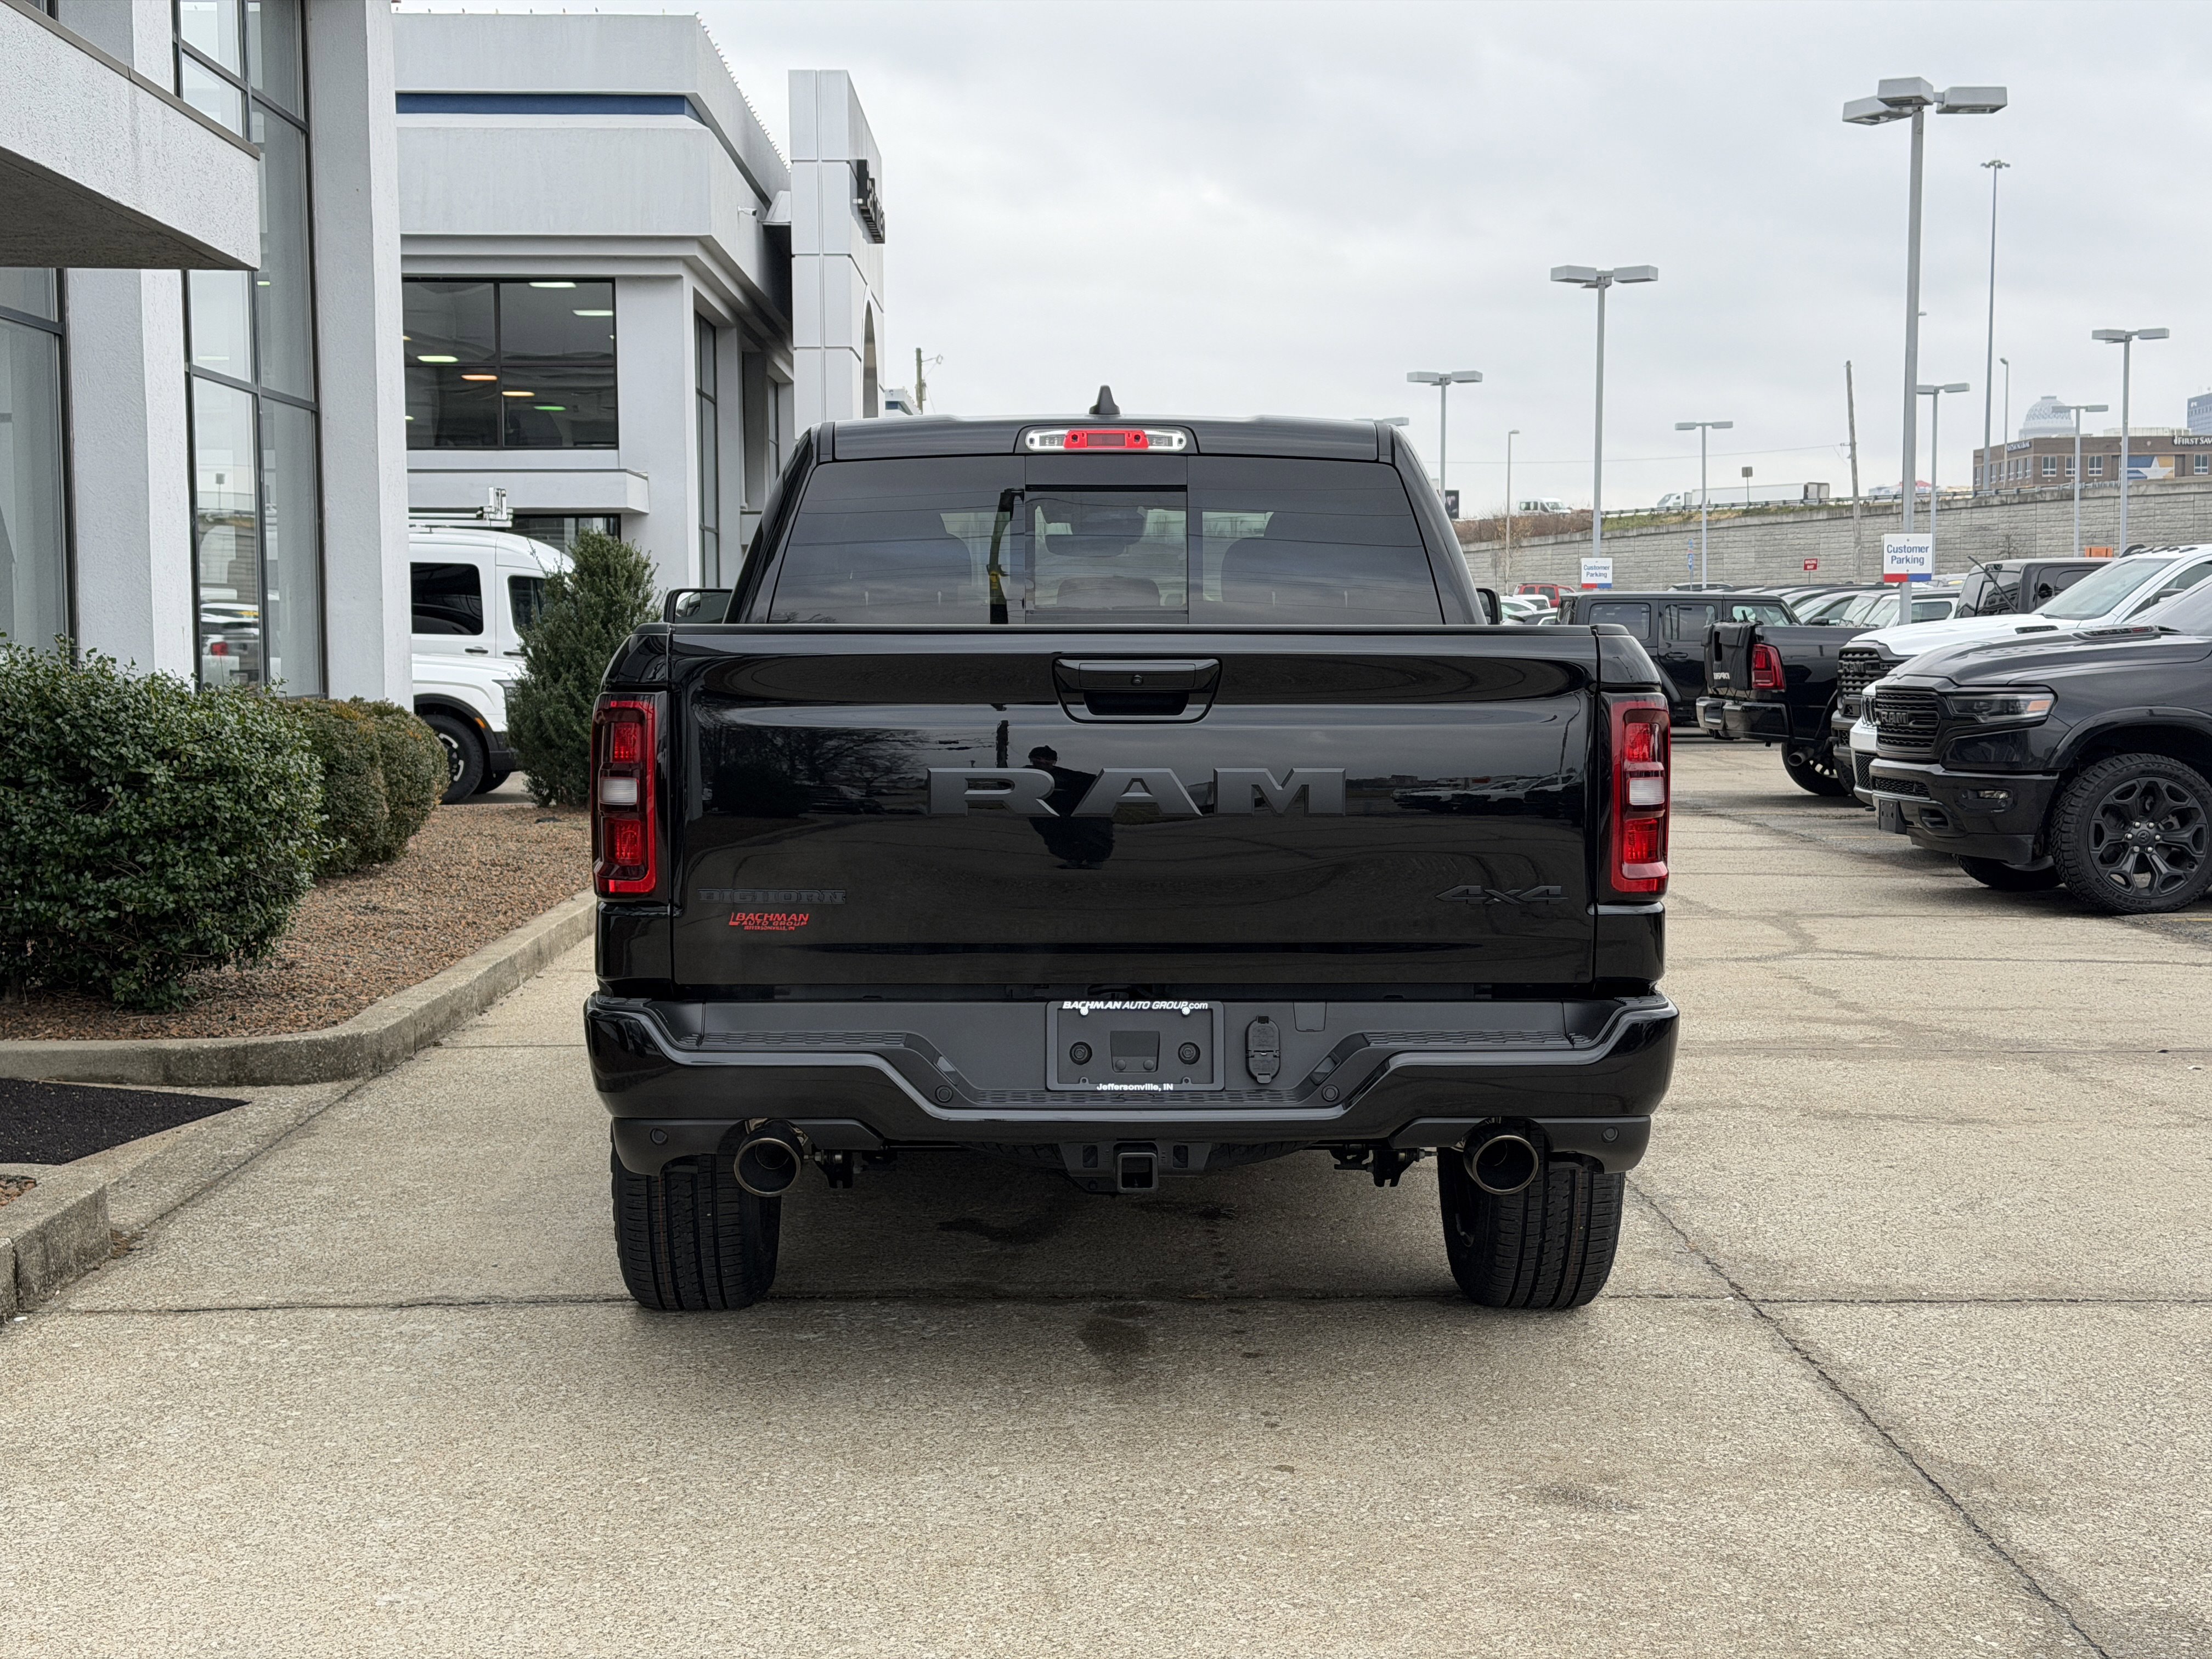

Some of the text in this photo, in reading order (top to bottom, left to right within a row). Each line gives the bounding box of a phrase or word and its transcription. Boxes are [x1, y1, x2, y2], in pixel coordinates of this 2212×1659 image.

[2178, 437, 2199, 445] FIRST
[1887, 544, 1929, 554] Customer
[1891, 555, 1925, 566] Parking
[1881, 712, 1909, 724] RAM
[928, 768, 1346, 816] RAM
[736, 913, 810, 922] BACHMAN
[1062, 1001, 1208, 1009] BACHMAN AUTO GROUPcom
[1096, 1083, 1161, 1092] Jeffersonville,
